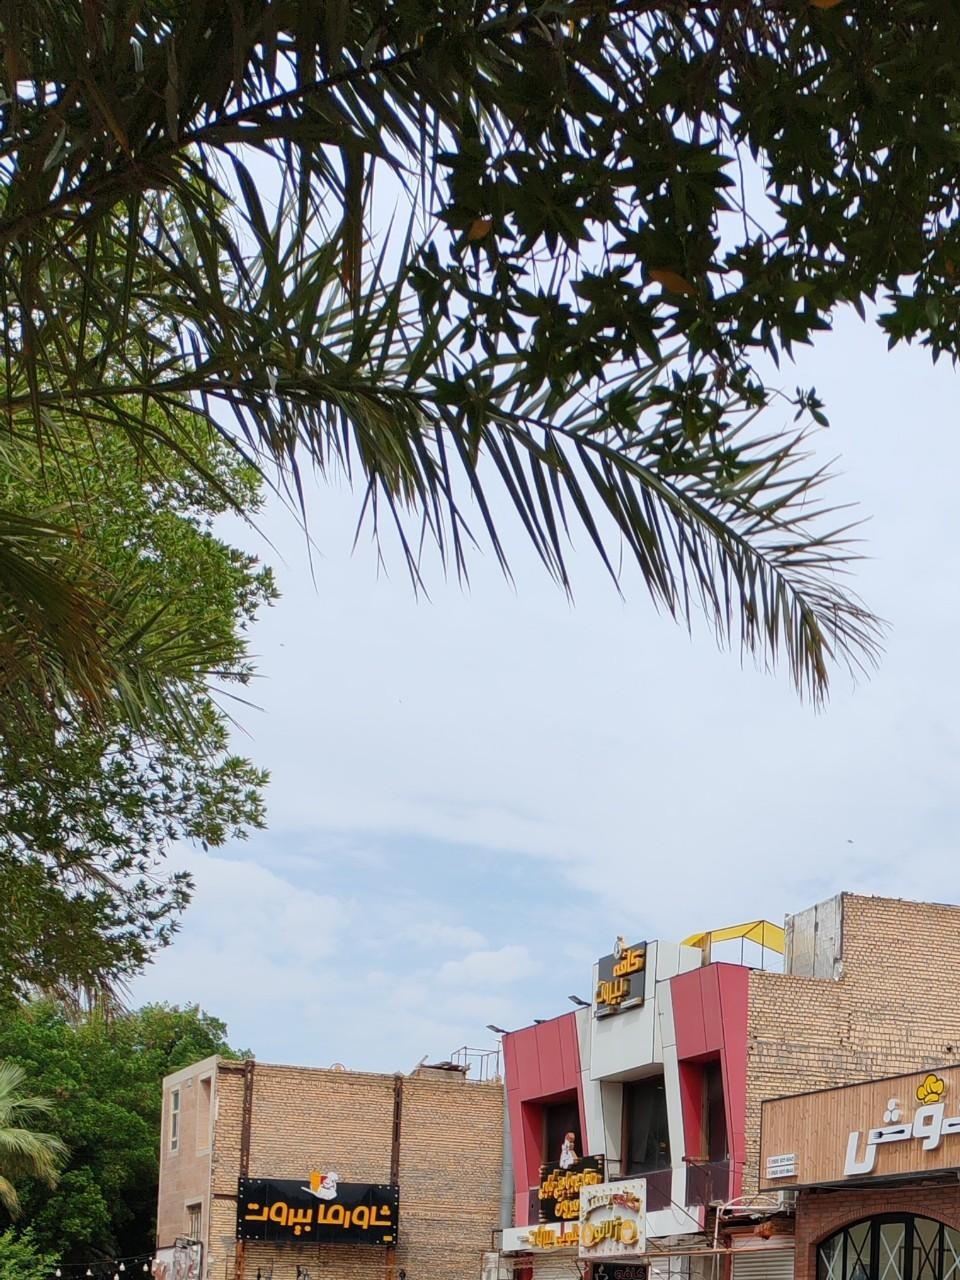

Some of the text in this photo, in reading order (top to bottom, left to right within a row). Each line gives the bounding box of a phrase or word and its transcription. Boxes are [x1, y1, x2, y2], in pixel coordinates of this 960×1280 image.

[612, 948, 645, 977] کافه
[596, 978, 629, 1005] بیروت
[245, 1201, 392, 1236] شاورما بیروت
